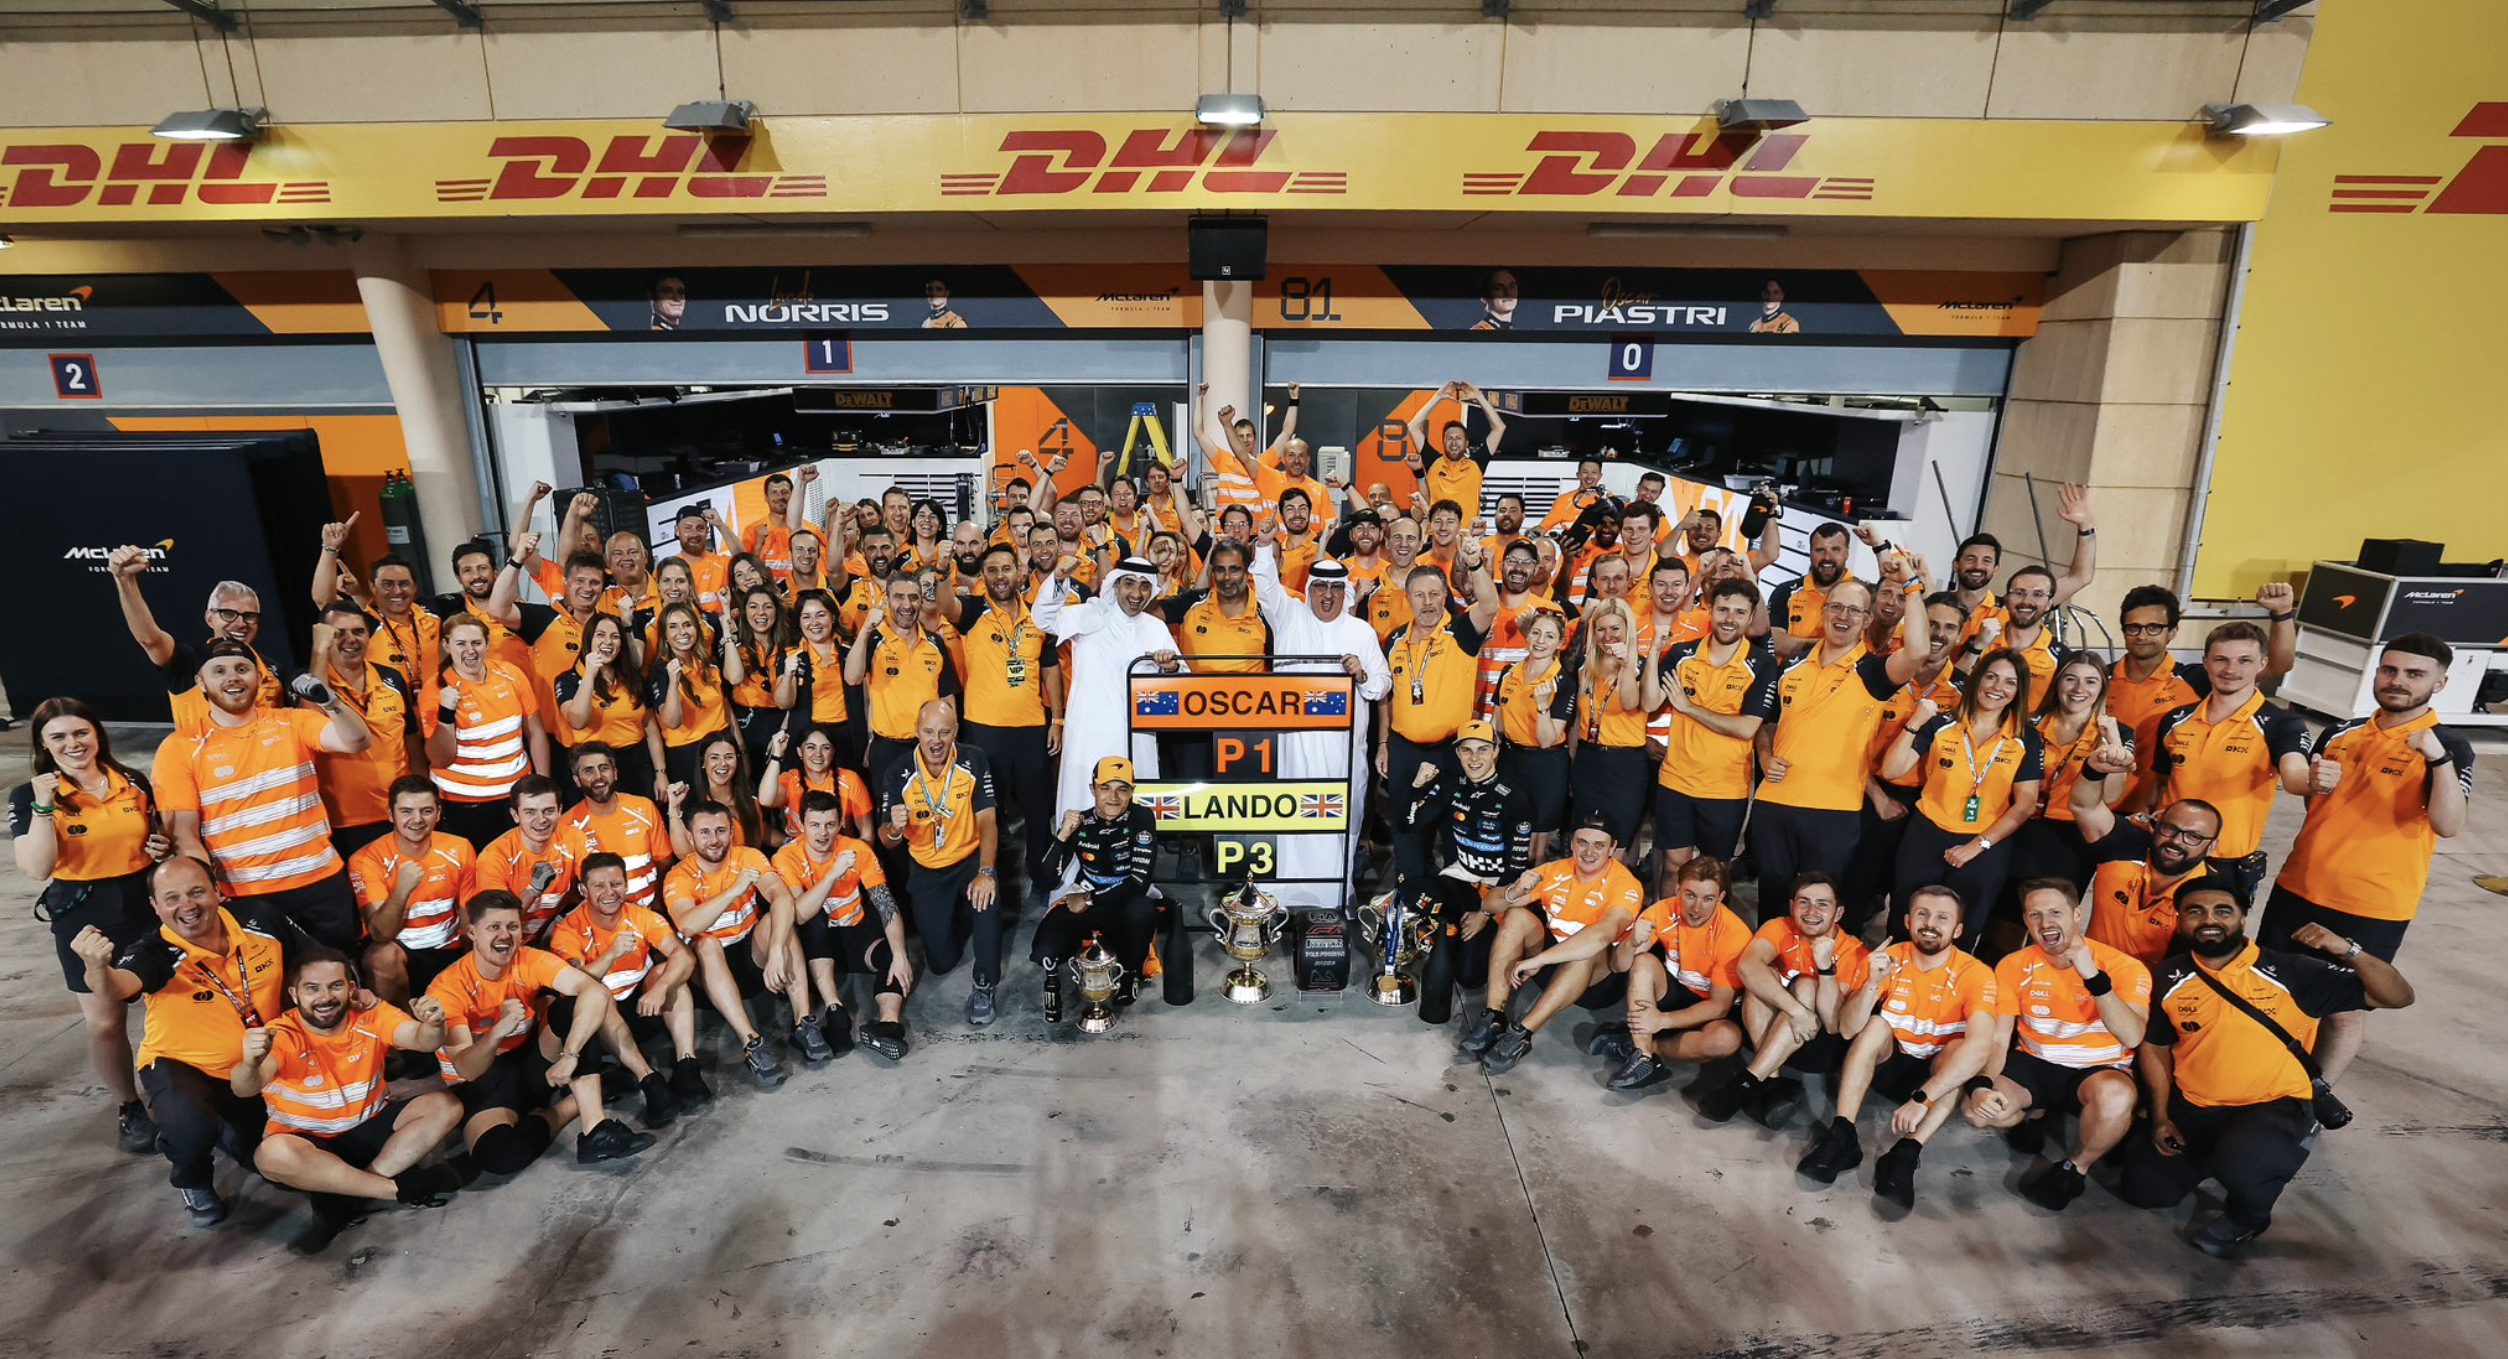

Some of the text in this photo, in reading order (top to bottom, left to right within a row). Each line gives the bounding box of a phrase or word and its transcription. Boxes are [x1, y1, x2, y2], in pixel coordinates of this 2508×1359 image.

[1, 143, 277, 207] DHL
[487, 136, 769, 199] DHL
[997, 130, 1293, 195] DHL
[1517, 131, 1821, 199] DHL
[0, 296, 82, 312] Laren
[469, 281, 502, 324] 4
[1096, 292, 1171, 302] McLaren
[1281, 277, 1341, 321] 81
[1601, 277, 1658, 311] Oscar
[1937, 300, 2013, 310] McLaren
[725, 303, 890, 323] NORRIS
[1553, 305, 1726, 326] PIASTRI
[822, 338, 833, 364] 1
[1622, 343, 1642, 371] 0
[65, 363, 87, 390] 2
[1038, 418, 1075, 462] 4
[63, 546, 166, 560] McLen
[1183, 690, 1300, 716] OSCAR
[1216, 737, 1272, 774] P1
[1183, 793, 1298, 819] LANDO
[1216, 841, 1274, 874] P3
